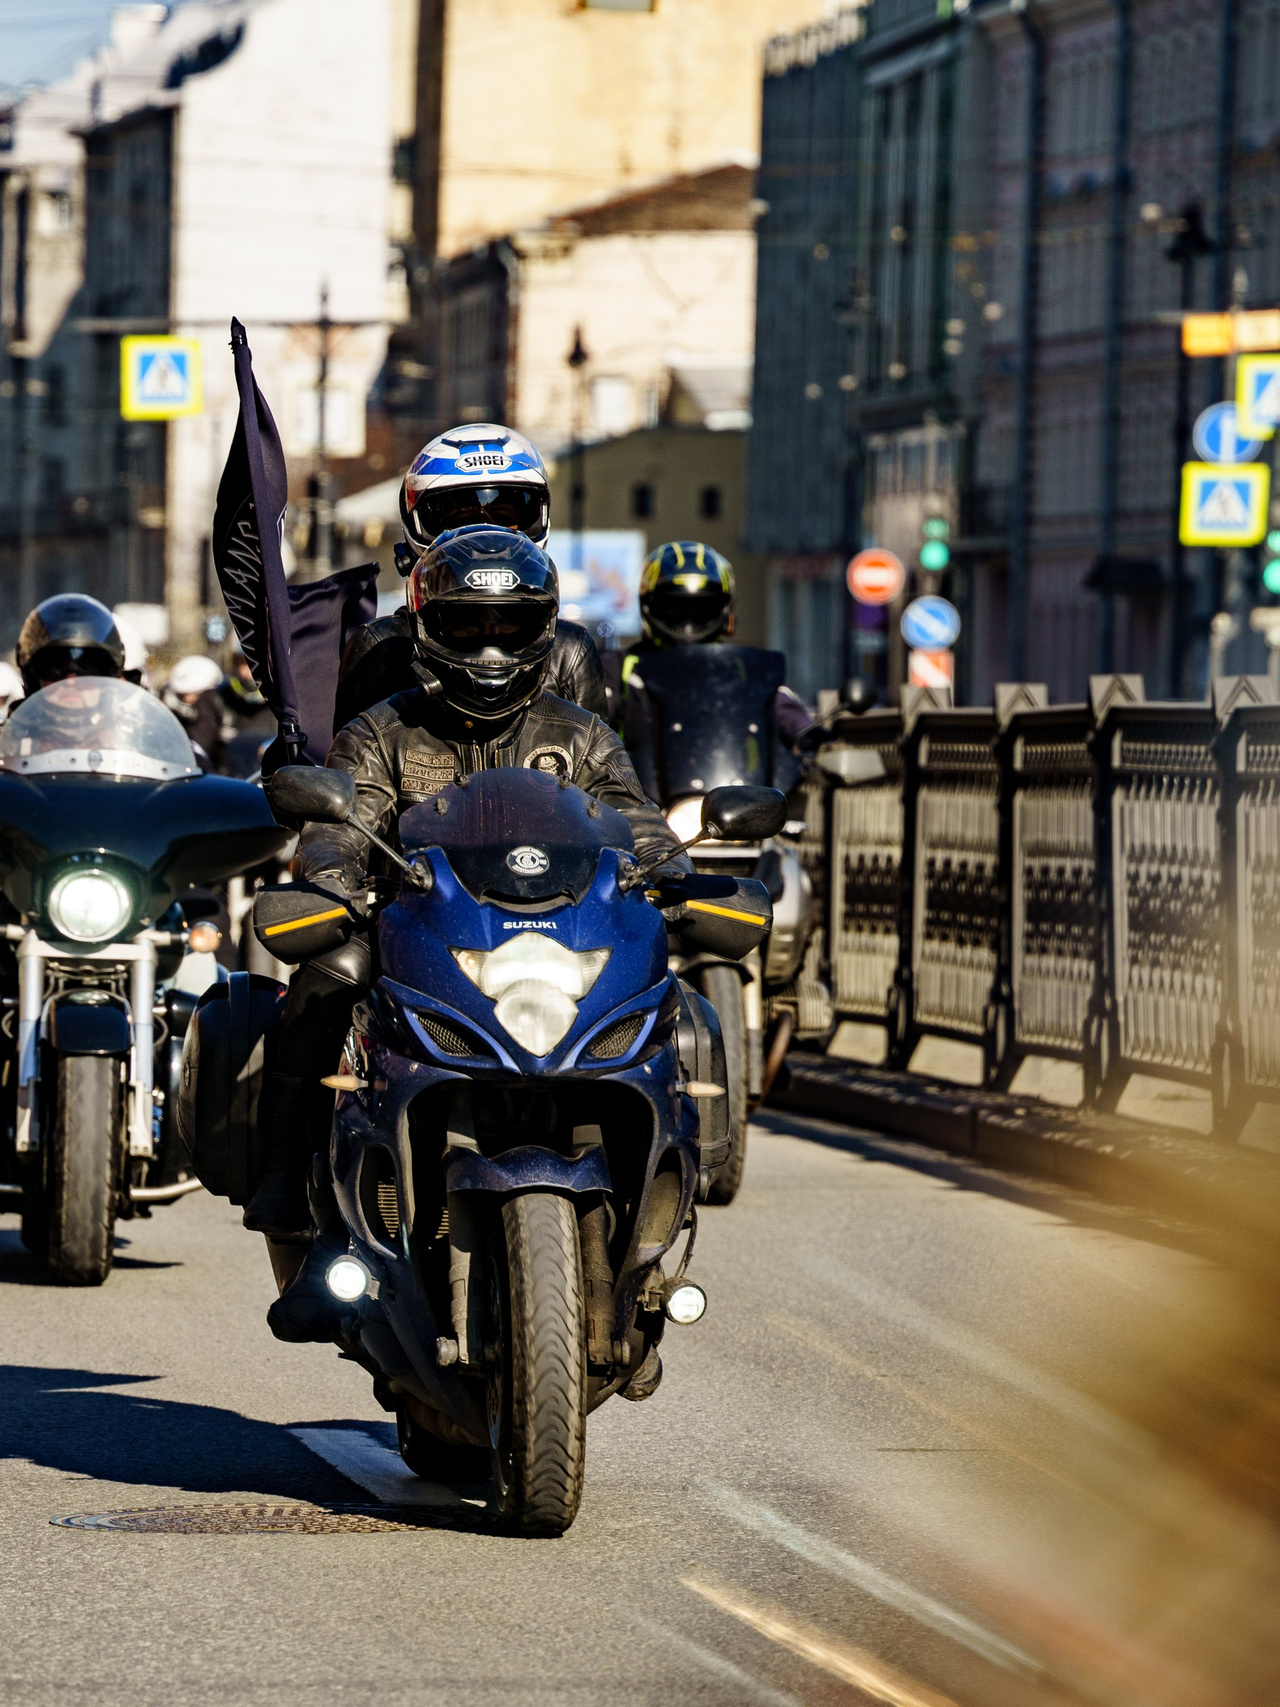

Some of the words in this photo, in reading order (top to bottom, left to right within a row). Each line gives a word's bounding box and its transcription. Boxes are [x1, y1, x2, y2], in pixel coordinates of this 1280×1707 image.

[464, 454, 505, 467] SHOEI
[472, 572, 514, 587] SHOEI
[502, 920, 558, 930] SUZUKI
